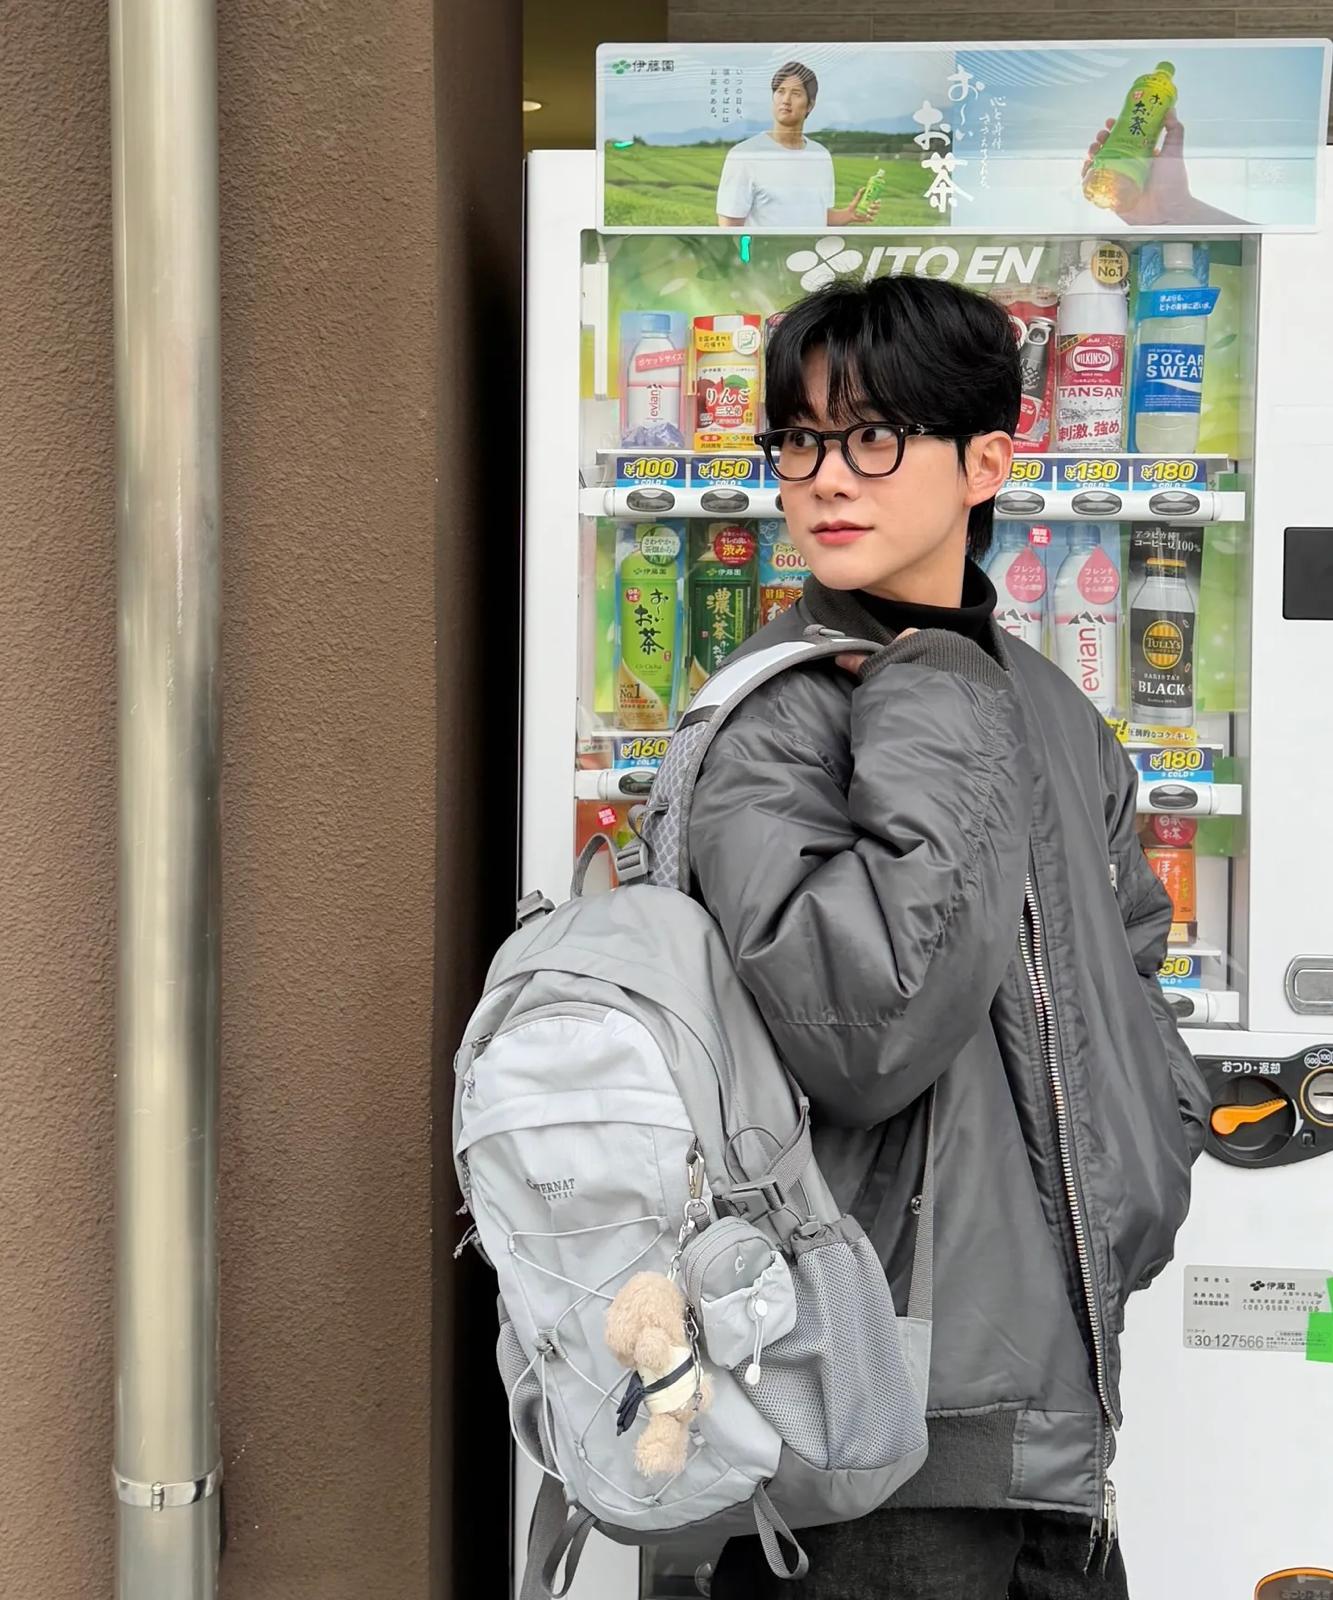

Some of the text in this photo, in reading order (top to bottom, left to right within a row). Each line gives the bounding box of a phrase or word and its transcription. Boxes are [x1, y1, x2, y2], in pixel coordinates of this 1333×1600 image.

[632, 60, 675, 72] 伊藤園
[912, 100, 975, 213] お茶
[863, 246, 1044, 283] ITO EN
[1098, 265, 1123, 277] No.1
[648, 388, 659, 416] evian
[706, 388, 751, 405] りんご
[1059, 386, 1124, 399] TANSAN
[1058, 420, 1121, 441] 刺激、強め
[625, 459, 675, 478] ¥100
[699, 460, 750, 479] ¥150
[1009, 461, 1042, 480] 50
[1066, 462, 1118, 480] ¥130
[1143, 462, 1195, 481] ¥180
[634, 604, 665, 655] お茶
[1077, 626, 1100, 693] evian
[1138, 681, 1185, 696] BLACK
[622, 739, 669, 758] ¥160
[1151, 750, 1202, 769] ¥180
[1306, 1056, 1319, 1065] 500
[1320, 1052, 1332, 1061] 100
[1221, 1061, 1281, 1074] おつり・返却
